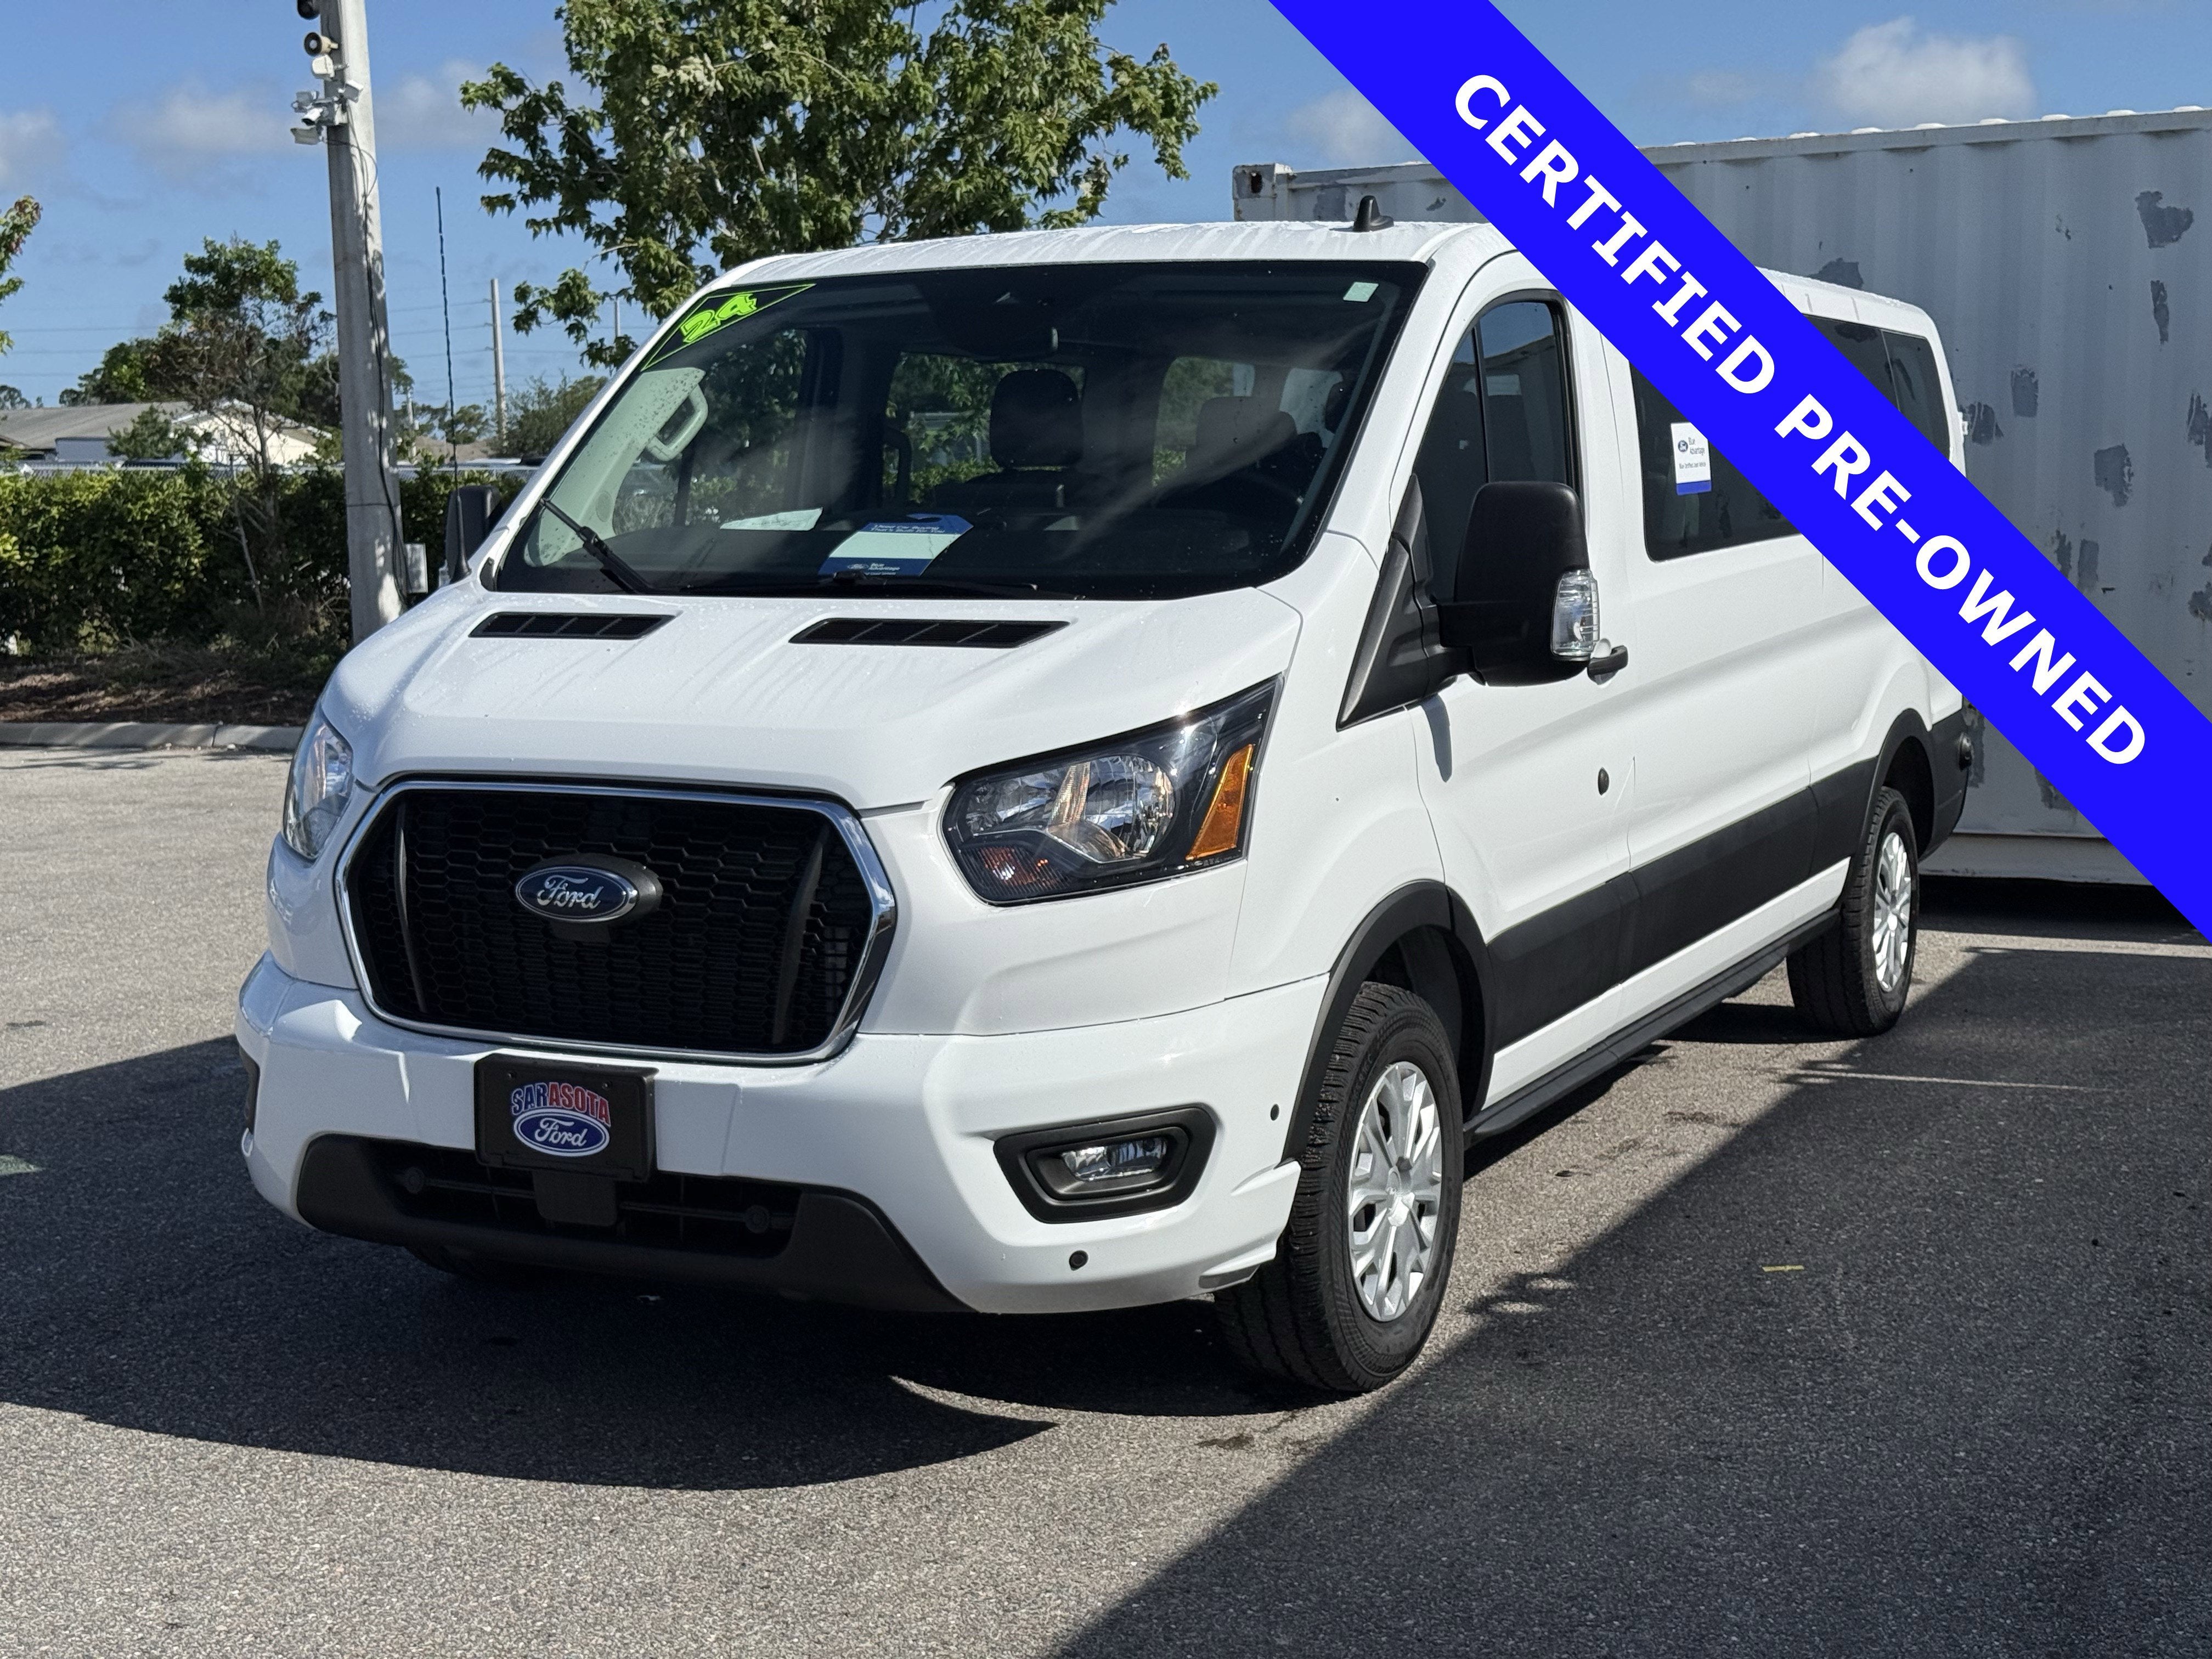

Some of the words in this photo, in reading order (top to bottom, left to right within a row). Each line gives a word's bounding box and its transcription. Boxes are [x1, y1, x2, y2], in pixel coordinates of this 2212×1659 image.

[680, 293, 758, 343] 24
[537, 874, 605, 910] Ford
[511, 1081, 612, 1128] SARASOTA
[534, 1117, 589, 1148] Ford
